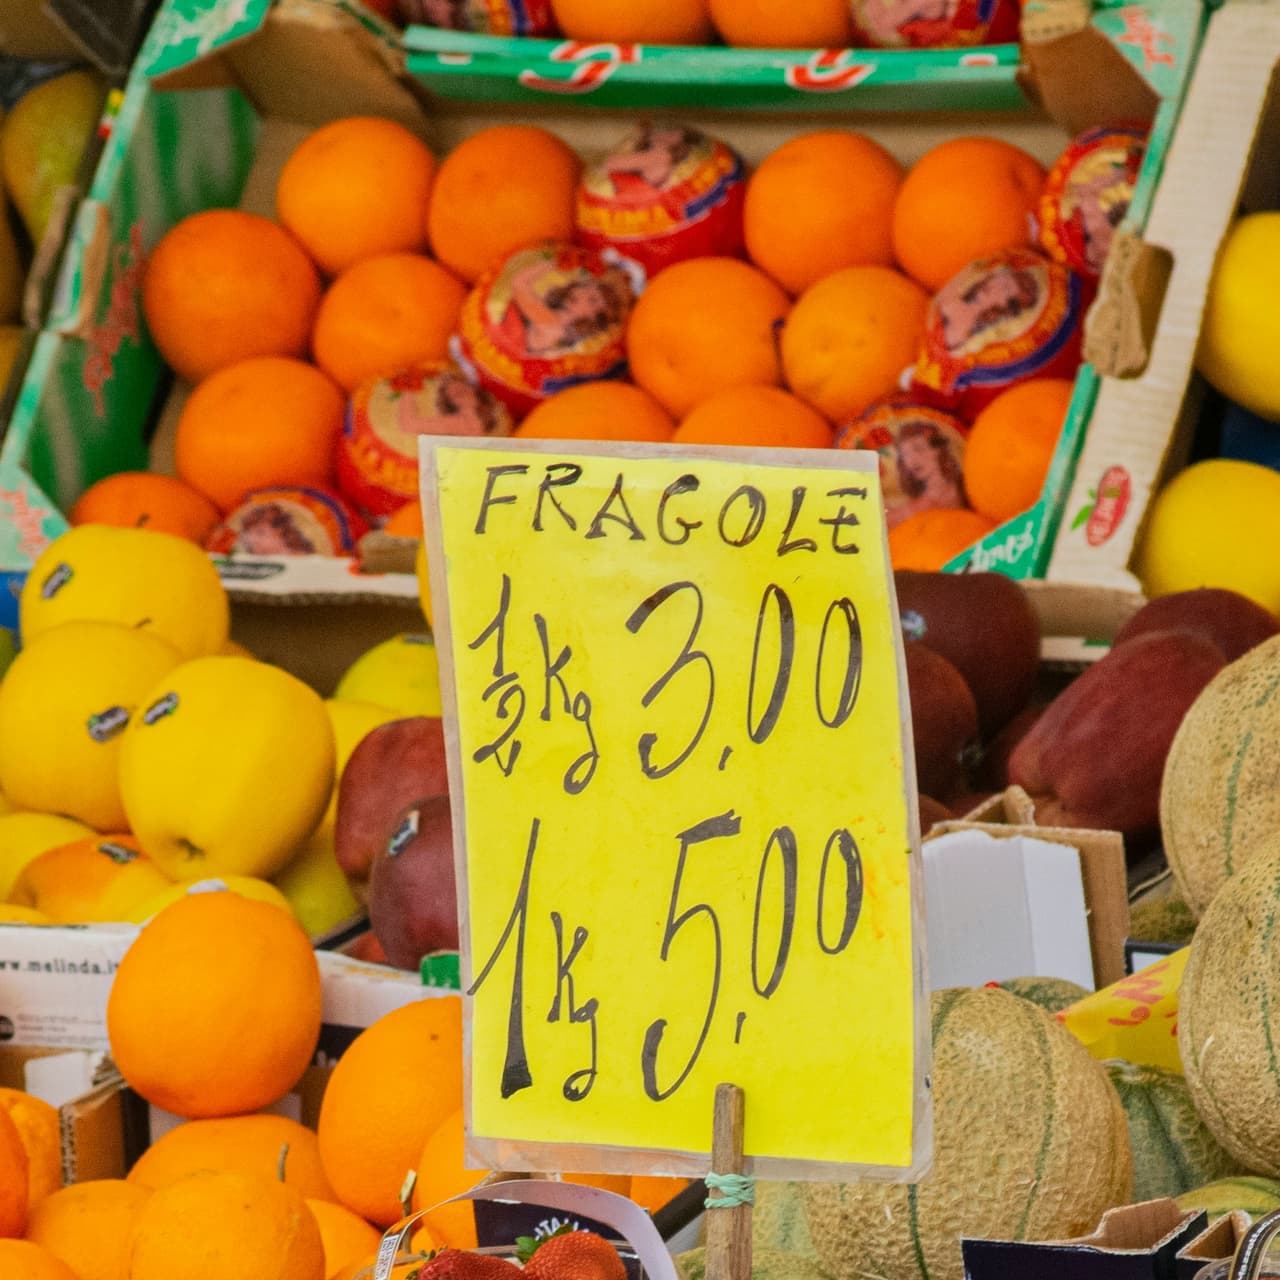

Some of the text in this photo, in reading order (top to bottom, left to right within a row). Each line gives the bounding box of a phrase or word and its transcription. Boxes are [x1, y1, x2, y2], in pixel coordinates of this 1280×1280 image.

[474, 462, 868, 557] FRAGOLE
[626, 580, 863, 780] 3,00
[469, 817, 533, 1099] 1
[642, 810, 863, 1104] 5,00
